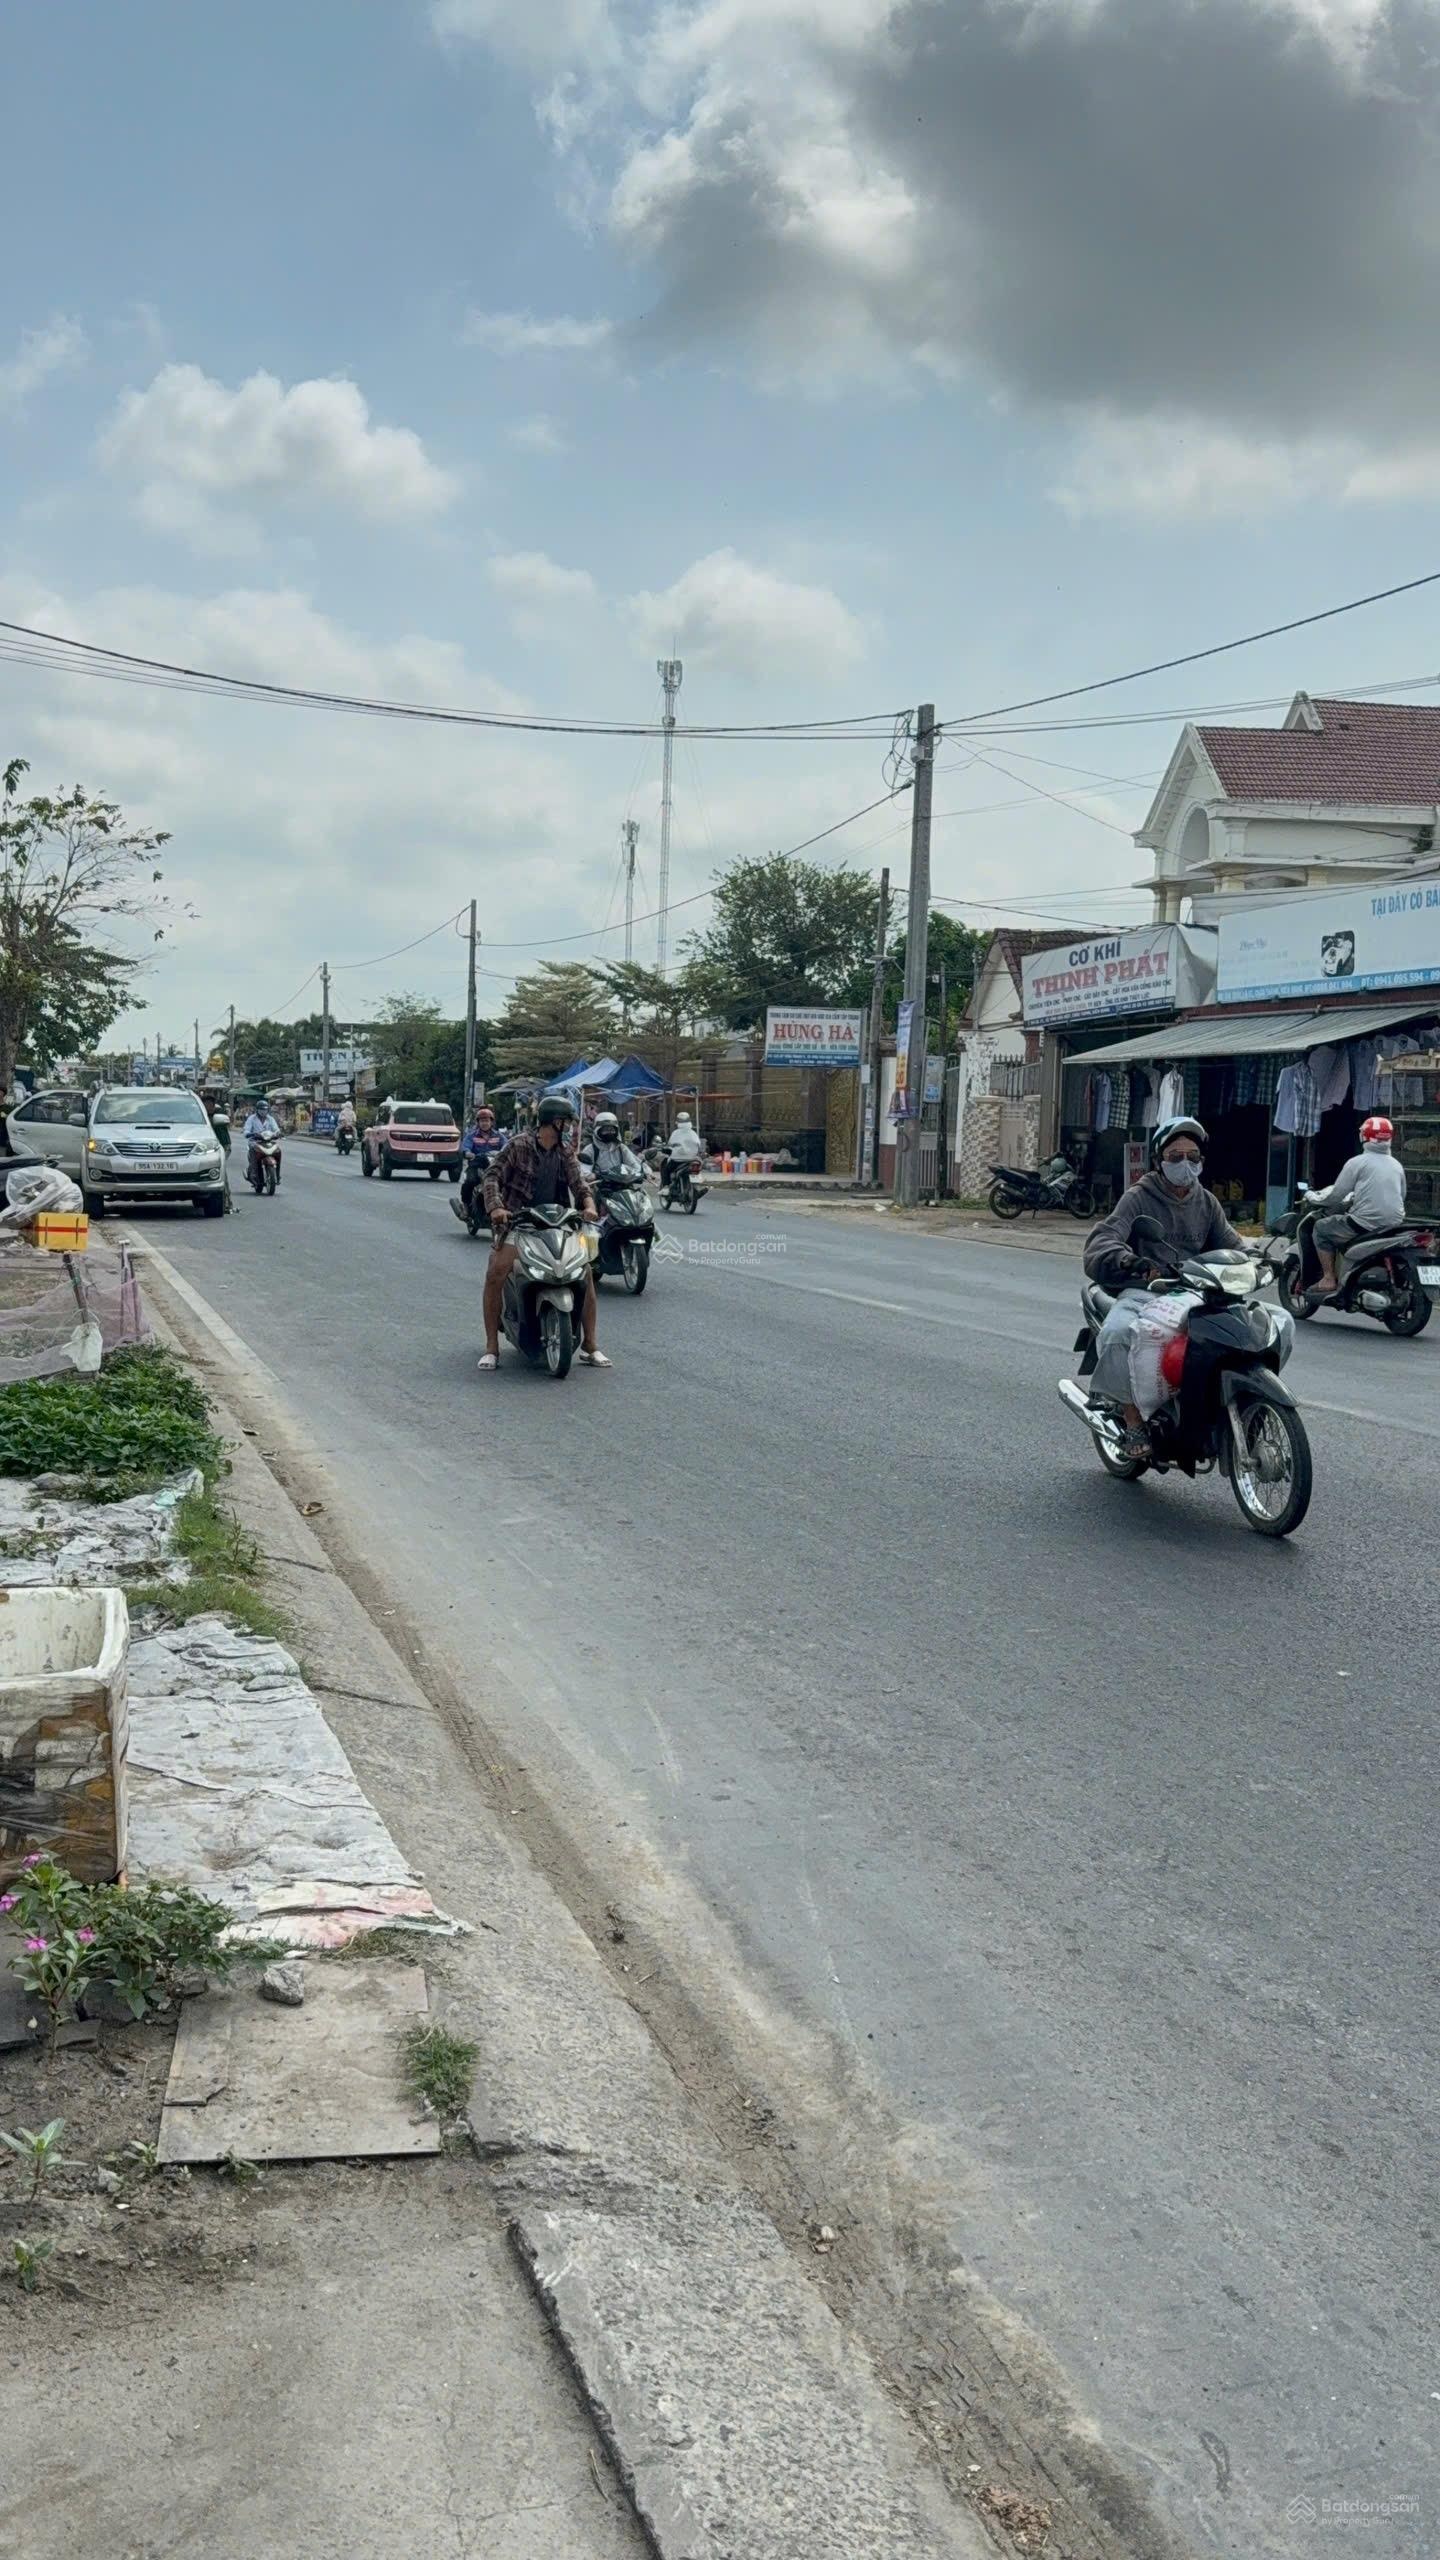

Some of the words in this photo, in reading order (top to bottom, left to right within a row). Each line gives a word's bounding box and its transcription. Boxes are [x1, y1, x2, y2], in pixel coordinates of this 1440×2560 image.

[1371, 897, 1387, 919] TẠI
[1410, 887, 1423, 910] CÓ
[1069, 945, 1090, 967] CƠ
[1094, 936, 1122, 962] KHÍ
[1032, 965, 1100, 998] THỊNH
[1103, 948, 1169, 985] PHÁT
[828, 1022, 855, 1041] HÀ
